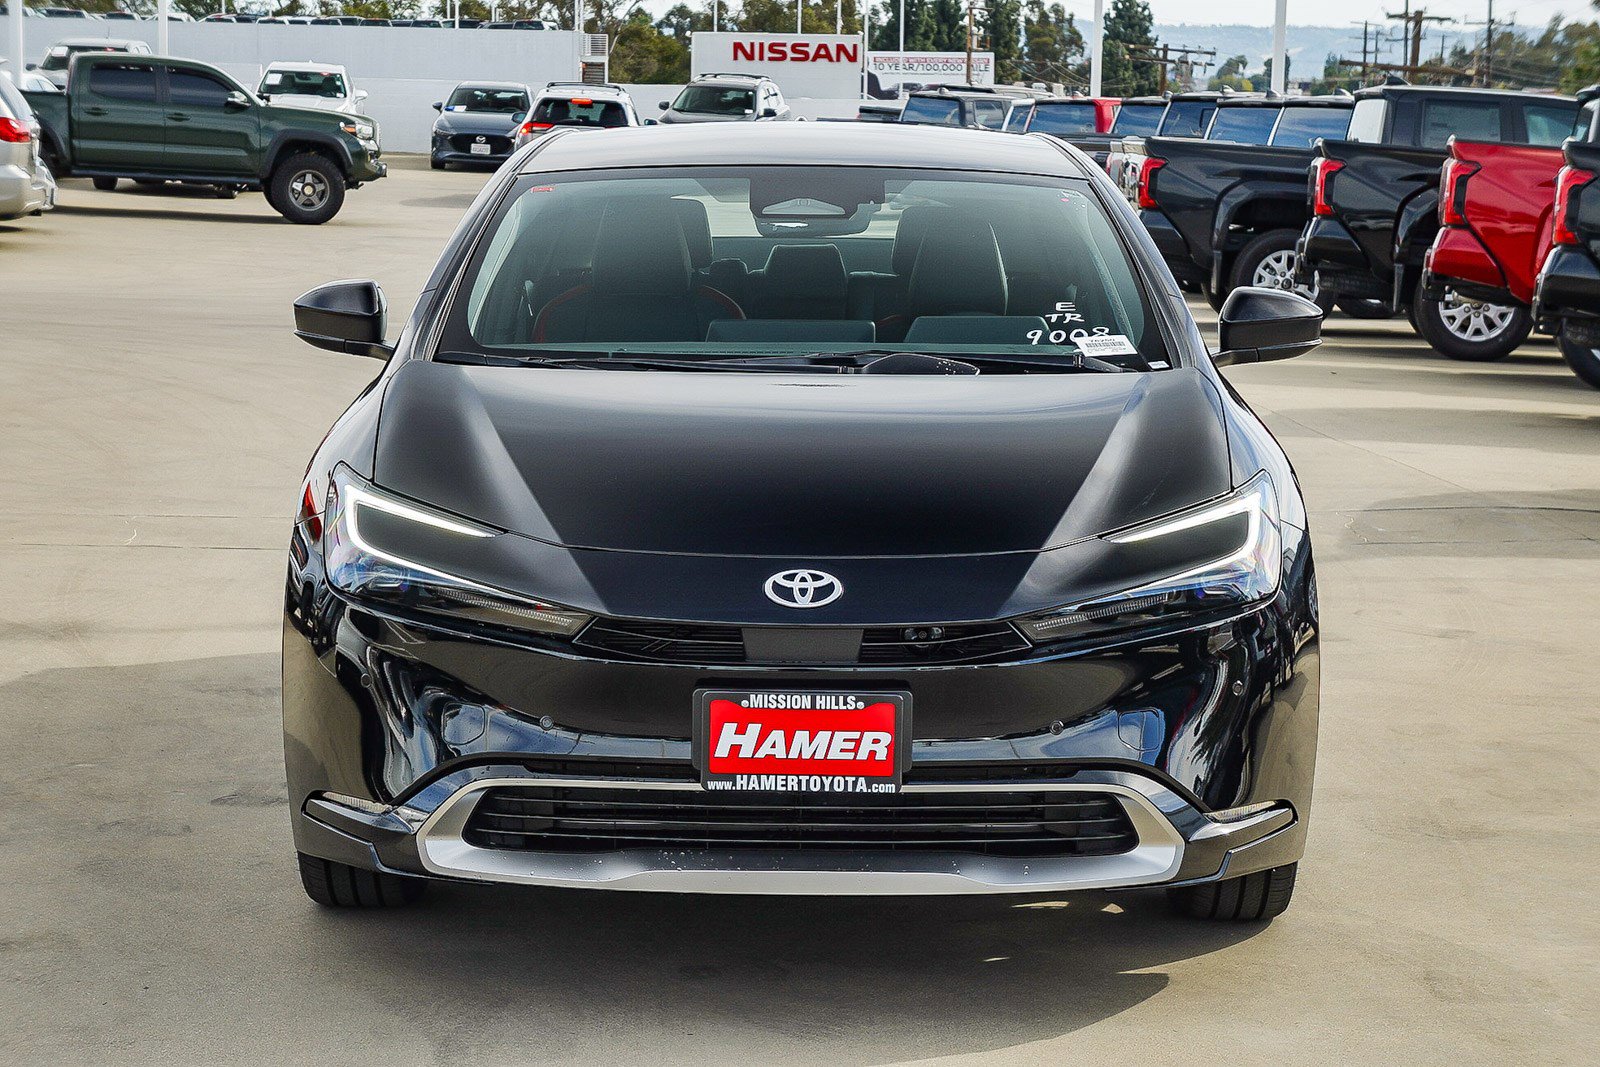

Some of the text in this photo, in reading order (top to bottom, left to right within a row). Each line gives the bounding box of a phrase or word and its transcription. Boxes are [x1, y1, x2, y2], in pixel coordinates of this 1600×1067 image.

[732, 41, 858, 62] NISSAN
[874, 63, 884, 71] 10
[1055, 302, 1076, 311] E
[1045, 313, 1085, 323] TR
[750, 694, 856, 710] MISSION HILLS
[714, 722, 892, 761] HAMER
[707, 774, 896, 794] www.HAMERTOYOTA.com
